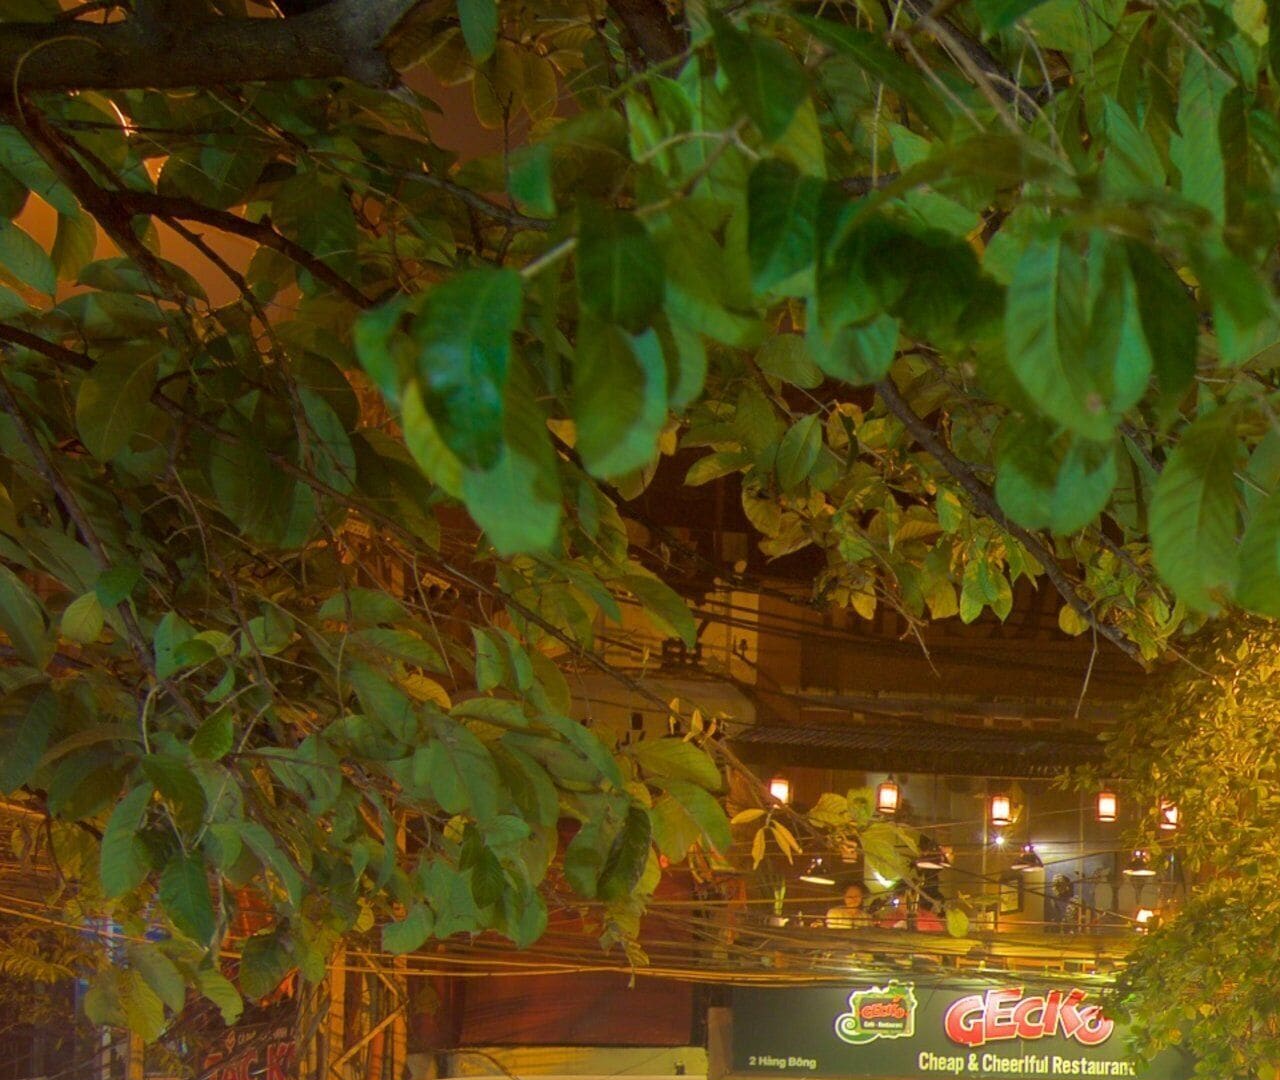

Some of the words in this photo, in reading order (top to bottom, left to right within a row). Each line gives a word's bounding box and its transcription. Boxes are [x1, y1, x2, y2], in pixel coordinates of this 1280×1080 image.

[944, 986, 1114, 1047] GECKO
[749, 1056, 756, 1066] 2
[918, 1051, 964, 1075] Cheap
[968, 1053, 980, 1072] &
